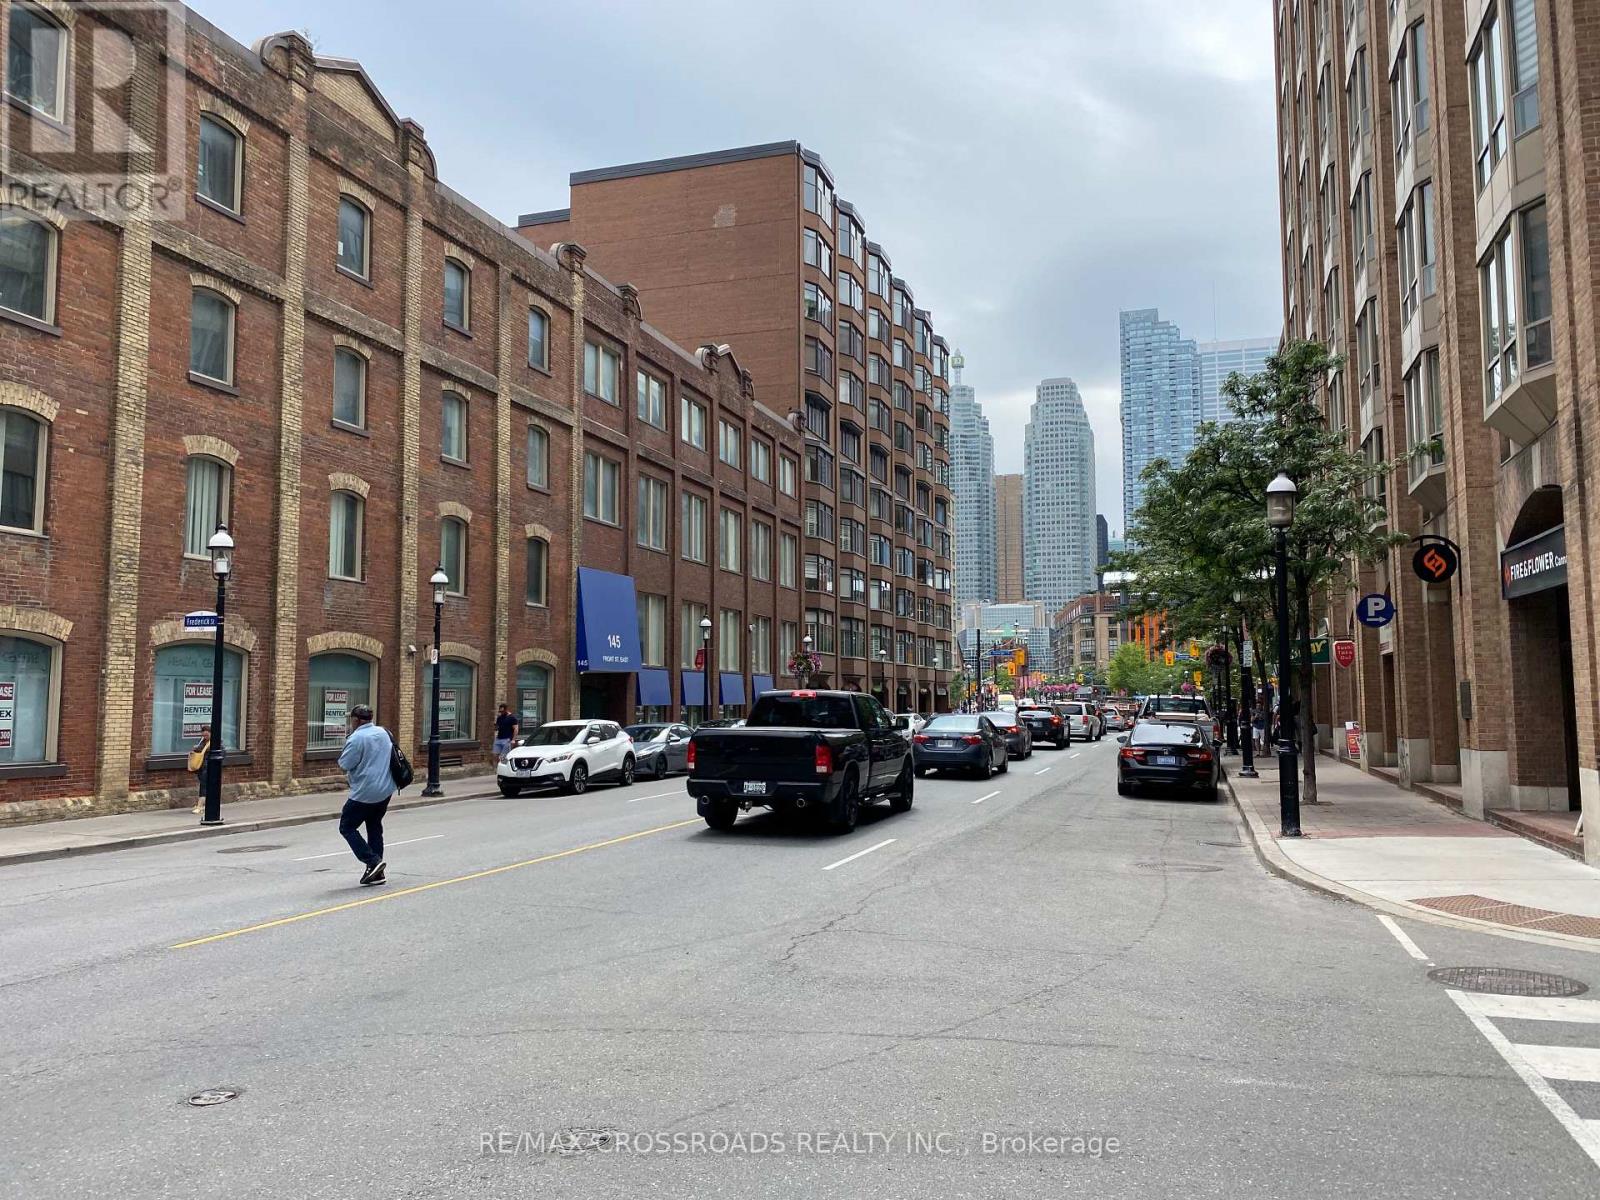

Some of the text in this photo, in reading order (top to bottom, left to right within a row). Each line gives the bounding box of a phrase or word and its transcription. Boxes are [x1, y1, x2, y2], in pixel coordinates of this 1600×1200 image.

[1367, 597, 1386, 617] P
[186, 617, 209, 626] Frederick
[607, 634, 621, 649] 145
[185, 686, 213, 696] FOR LEASE
